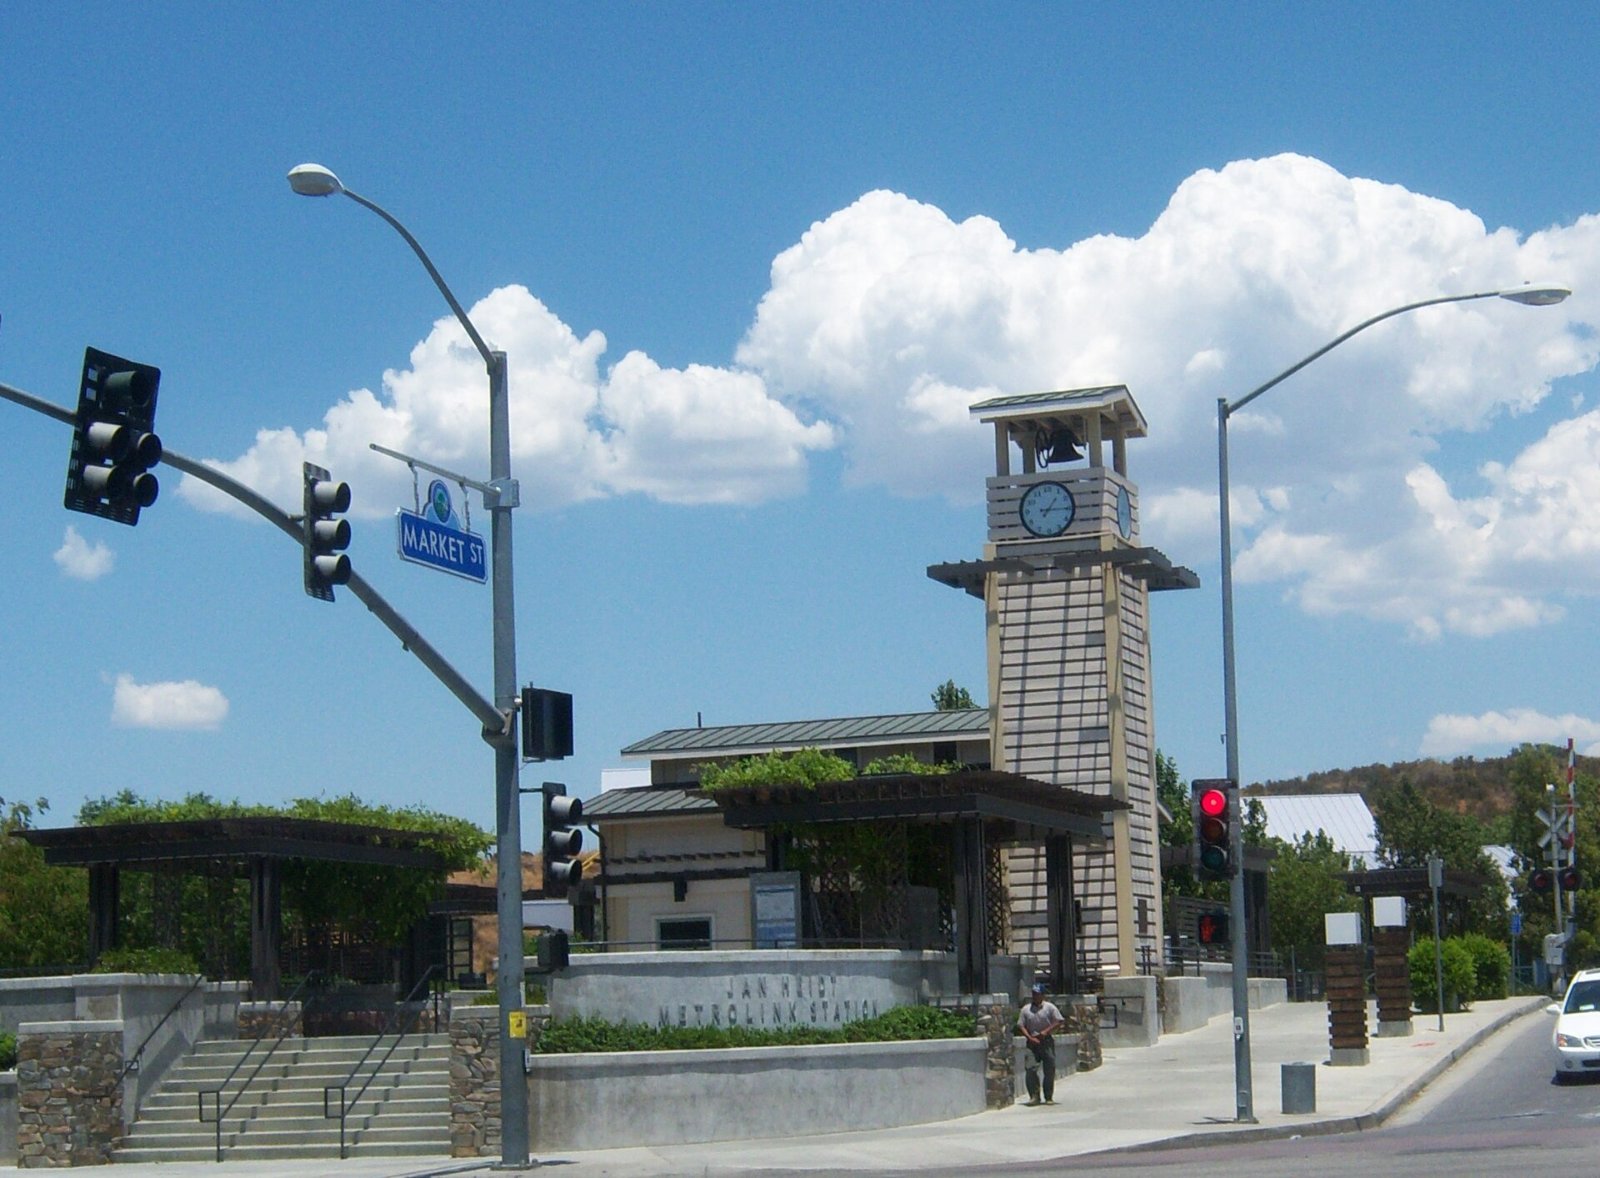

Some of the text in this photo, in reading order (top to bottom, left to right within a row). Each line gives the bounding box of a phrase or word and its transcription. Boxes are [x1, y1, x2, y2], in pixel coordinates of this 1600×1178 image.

[403, 523, 483, 564] MARKET ST
[726, 976, 767, 999] JAN
[657, 1000, 878, 1027] METROLINK STATION
